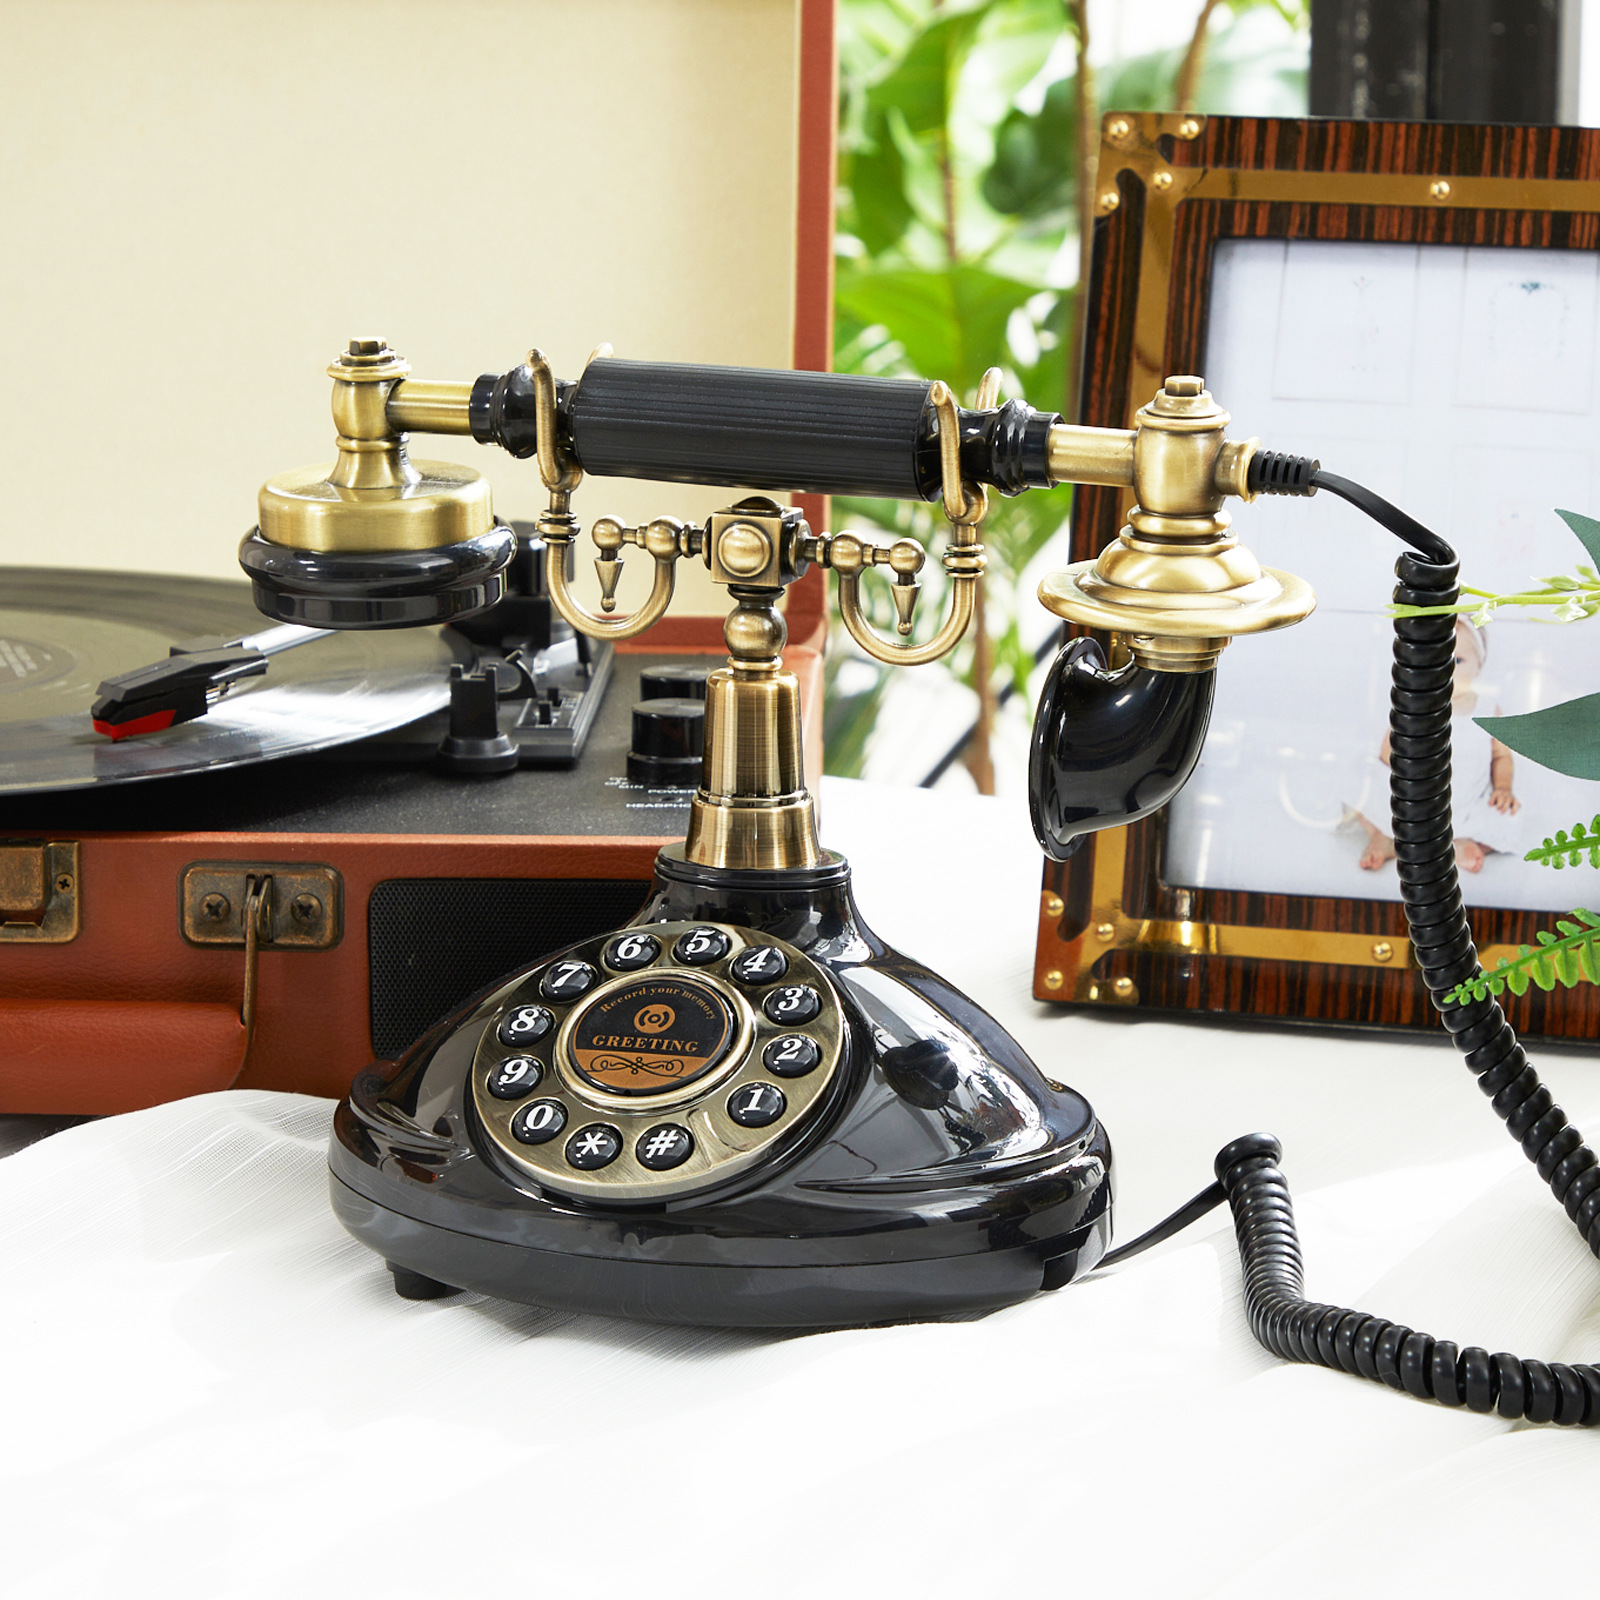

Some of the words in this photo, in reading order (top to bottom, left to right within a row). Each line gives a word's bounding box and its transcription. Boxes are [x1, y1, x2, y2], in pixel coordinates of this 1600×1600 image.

[617, 935, 645, 960] 6
[686, 930, 716, 954] 5
[742, 947, 771, 973] 4
[551, 962, 586, 988] 7
[600, 986, 647, 1013] Record
[650, 985, 680, 996] your
[682, 989, 718, 1020] memory
[778, 987, 804, 1011] 3
[511, 1008, 539, 1032] 8
[591, 1034, 699, 1053] GREETING
[776, 1037, 803, 1061] 2
[499, 1059, 529, 1086] 9
[739, 1088, 765, 1113] 1
[526, 1105, 554, 1130] 0
